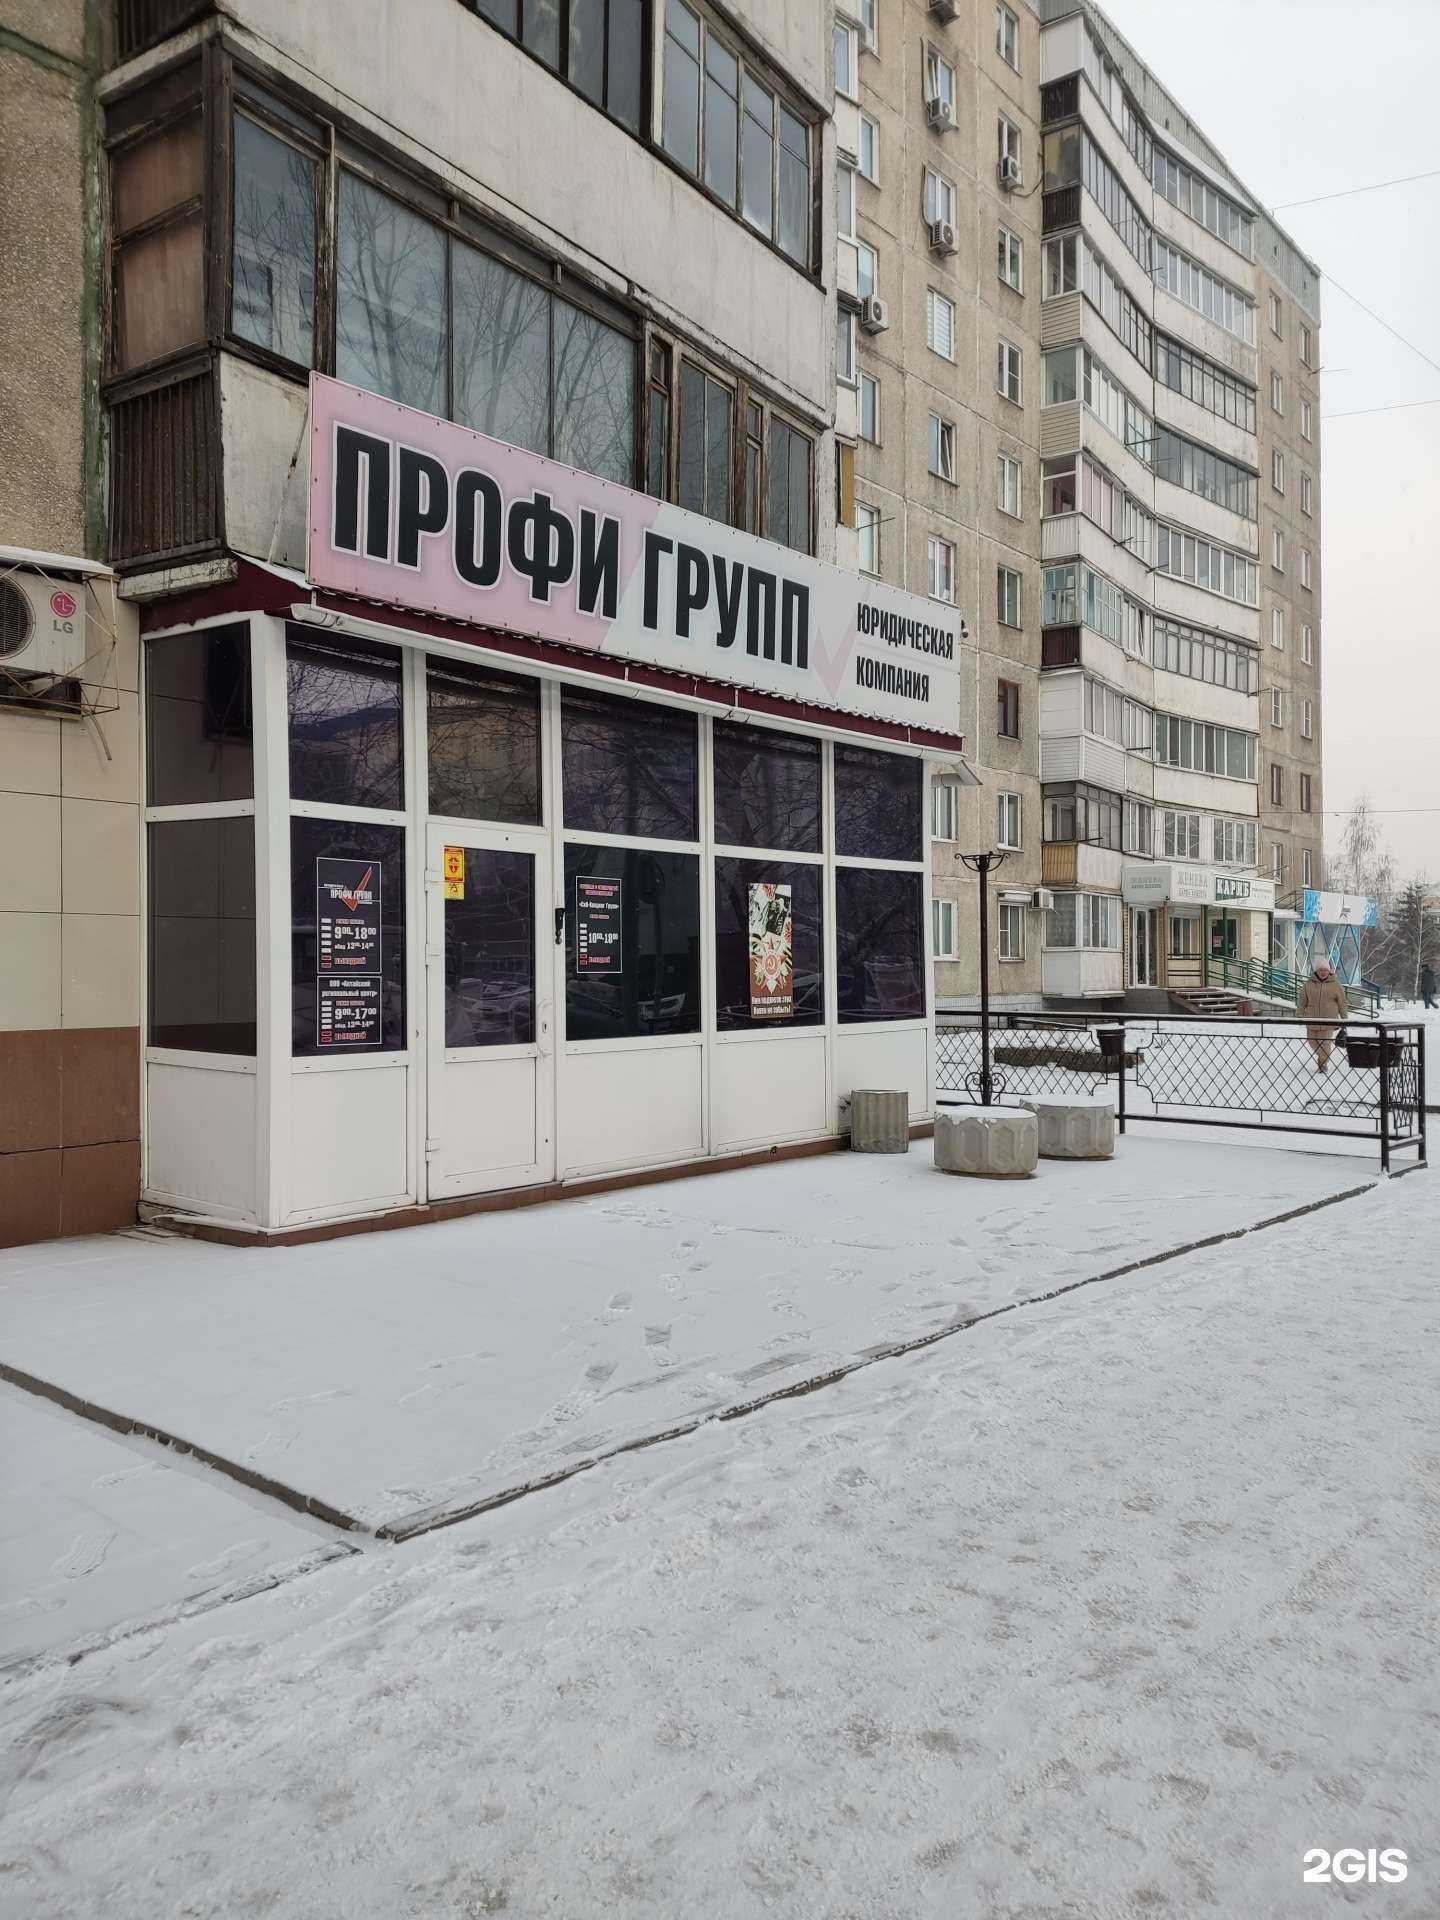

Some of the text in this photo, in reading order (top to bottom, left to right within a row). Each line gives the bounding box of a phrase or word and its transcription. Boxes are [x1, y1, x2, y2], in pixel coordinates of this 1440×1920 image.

[335, 426, 810, 670] ПРОФИ ГРУПП
[53, 619, 74, 634] LG
[857, 602, 954, 660] ЮРИДИЧЕСКАЯ
[856, 657, 930, 703] КОМПАНИЯ
